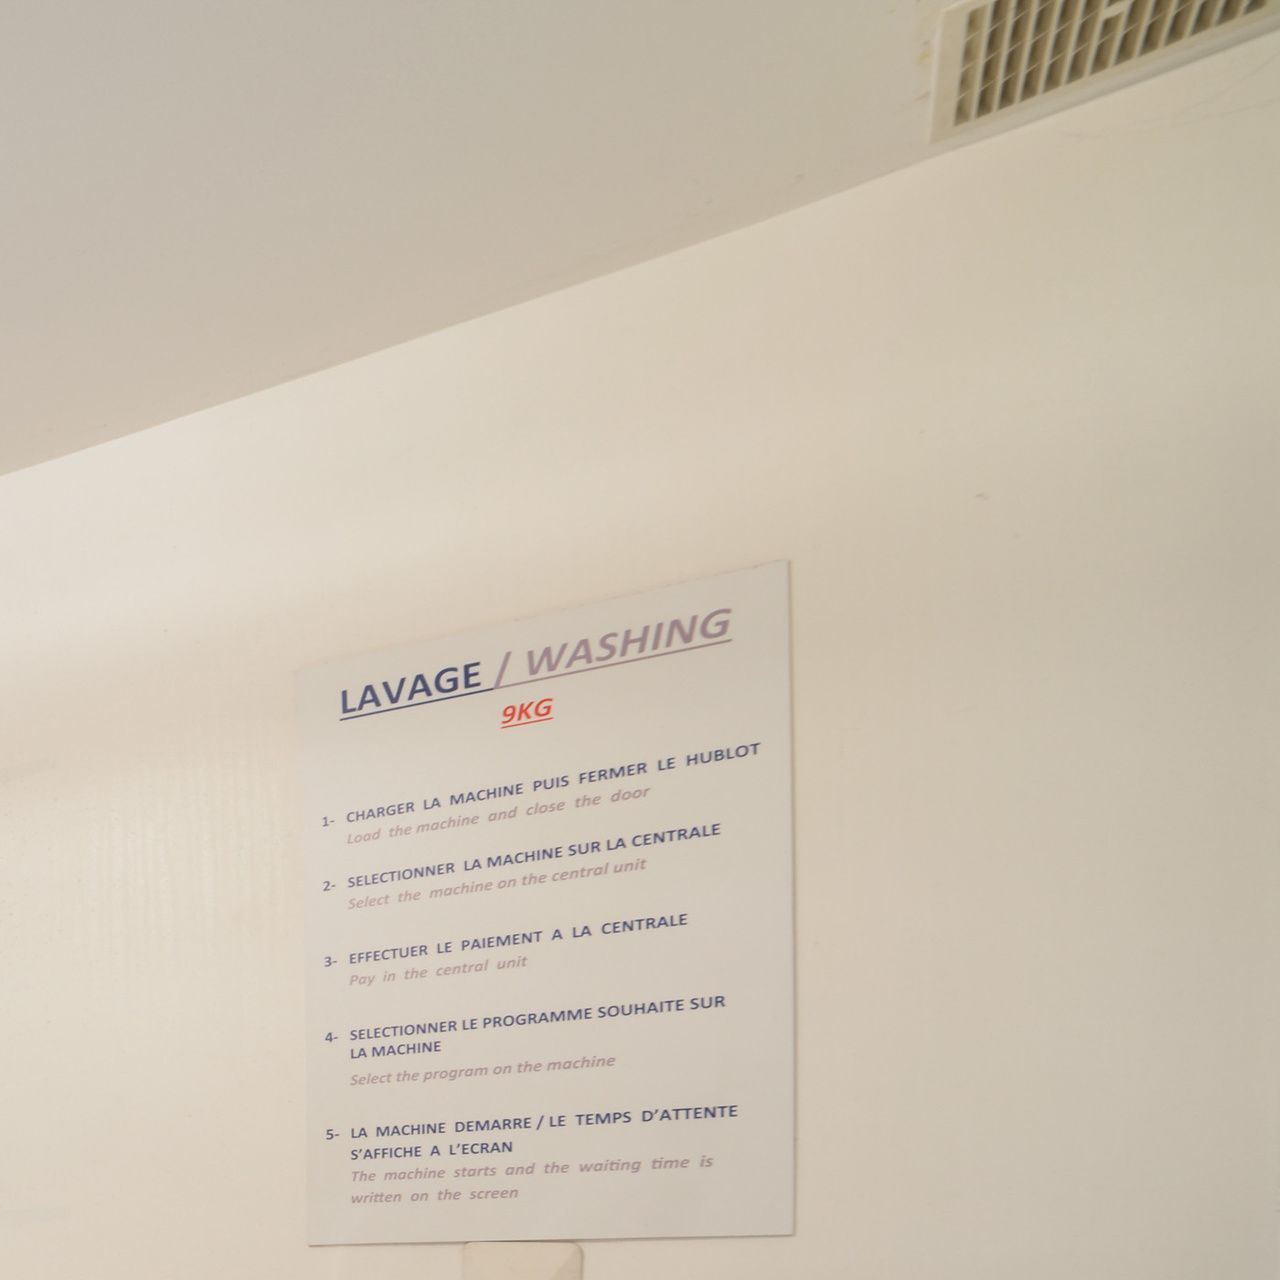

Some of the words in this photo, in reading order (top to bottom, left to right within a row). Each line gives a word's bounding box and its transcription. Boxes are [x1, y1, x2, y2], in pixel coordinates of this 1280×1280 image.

[340, 662, 481, 715] LAVAGE
[494, 651, 511, 688] /
[528, 609, 731, 675] WASHING
[501, 698, 554, 726] 9KG
[346, 802, 416, 822] CHARGER
[424, 798, 441, 810] LA
[450, 783, 523, 805] MACHINE
[533, 776, 570, 792] PUIS
[576, 763, 647, 784] FERMER
[658, 757, 676, 771] LE
[687, 742, 761, 766] HUBLOT
[348, 863, 455, 888] SELECTIONNER
[464, 859, 482, 871] LA
[487, 846, 563, 868] MACHINE
[568, 841, 601, 856] SUR
[606, 838, 627, 851] LA
[632, 823, 722, 847] CENTRALE
[350, 945, 428, 964] EFFECTUER
[437, 942, 452, 954] LE
[461, 931, 543, 951] PAIEMENT
[552, 929, 563, 940] A
[573, 926, 592, 938] LA
[601, 913, 688, 934] CENTRALE
[350, 1021, 457, 1041] SELECTIONNER
[462, 1018, 478, 1030] LE
[483, 1008, 592, 1028] PROGRAMME
[598, 999, 685, 1018] SOUHAITE
[690, 996, 725, 1010] SUR
[351, 1048, 368, 1059] LA
[372, 1040, 442, 1057] MACHINE
[351, 1128, 368, 1138] LA
[376, 1122, 448, 1137] MACHINE
[455, 1117, 532, 1135] DEMARRE
[549, 1115, 566, 1127] LE
[575, 1112, 632, 1126] TEMPS
[642, 1105, 738, 1122] D'ATTENTE
[350, 1145, 424, 1160] S'AFFICHE
[430, 1145, 440, 1156] A
[449, 1141, 512, 1155] L'ECRAN
[351, 1192, 405, 1203] written
[408, 1192, 429, 1202] on
[438, 1188, 464, 1200] the
[469, 1186, 519, 1200] screen
